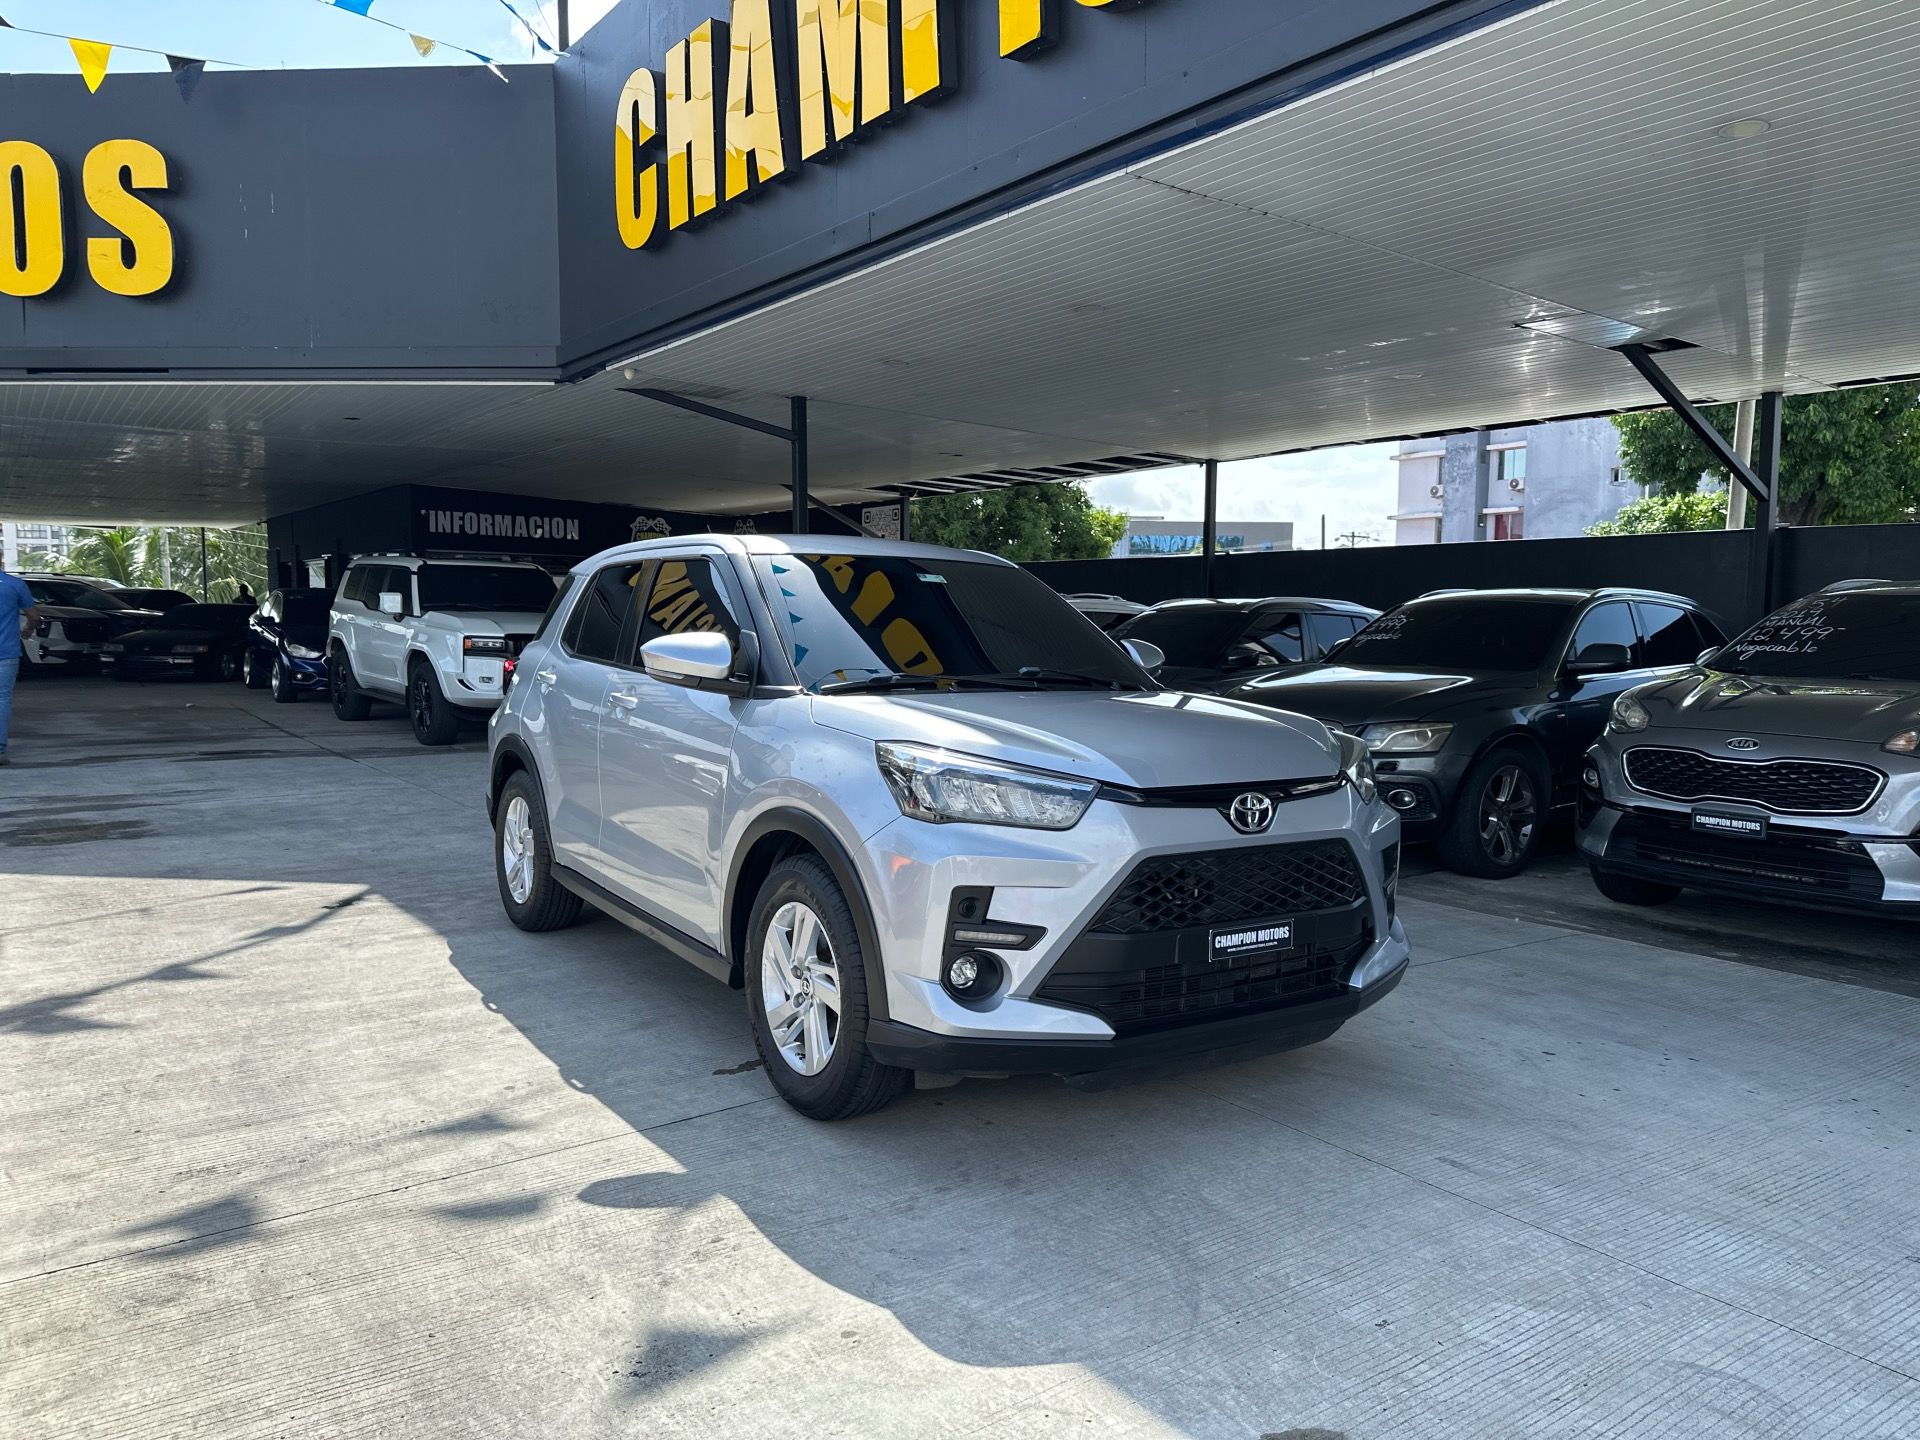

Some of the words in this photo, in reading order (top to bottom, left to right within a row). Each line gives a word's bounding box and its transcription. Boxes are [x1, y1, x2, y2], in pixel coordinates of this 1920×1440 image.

[616, 0, 1115, 249] CHAM
[429, 510, 579, 540] INFORMACION
[1760, 616, 1827, 628] MANUAL
[1729, 641, 1818, 660] Negociable
[1695, 815, 1731, 827] CHAMPION
[1731, 819, 1761, 831] MOTORS
[1214, 930, 1257, 949] CHAMPION
[1257, 926, 1290, 942] MOTORS
